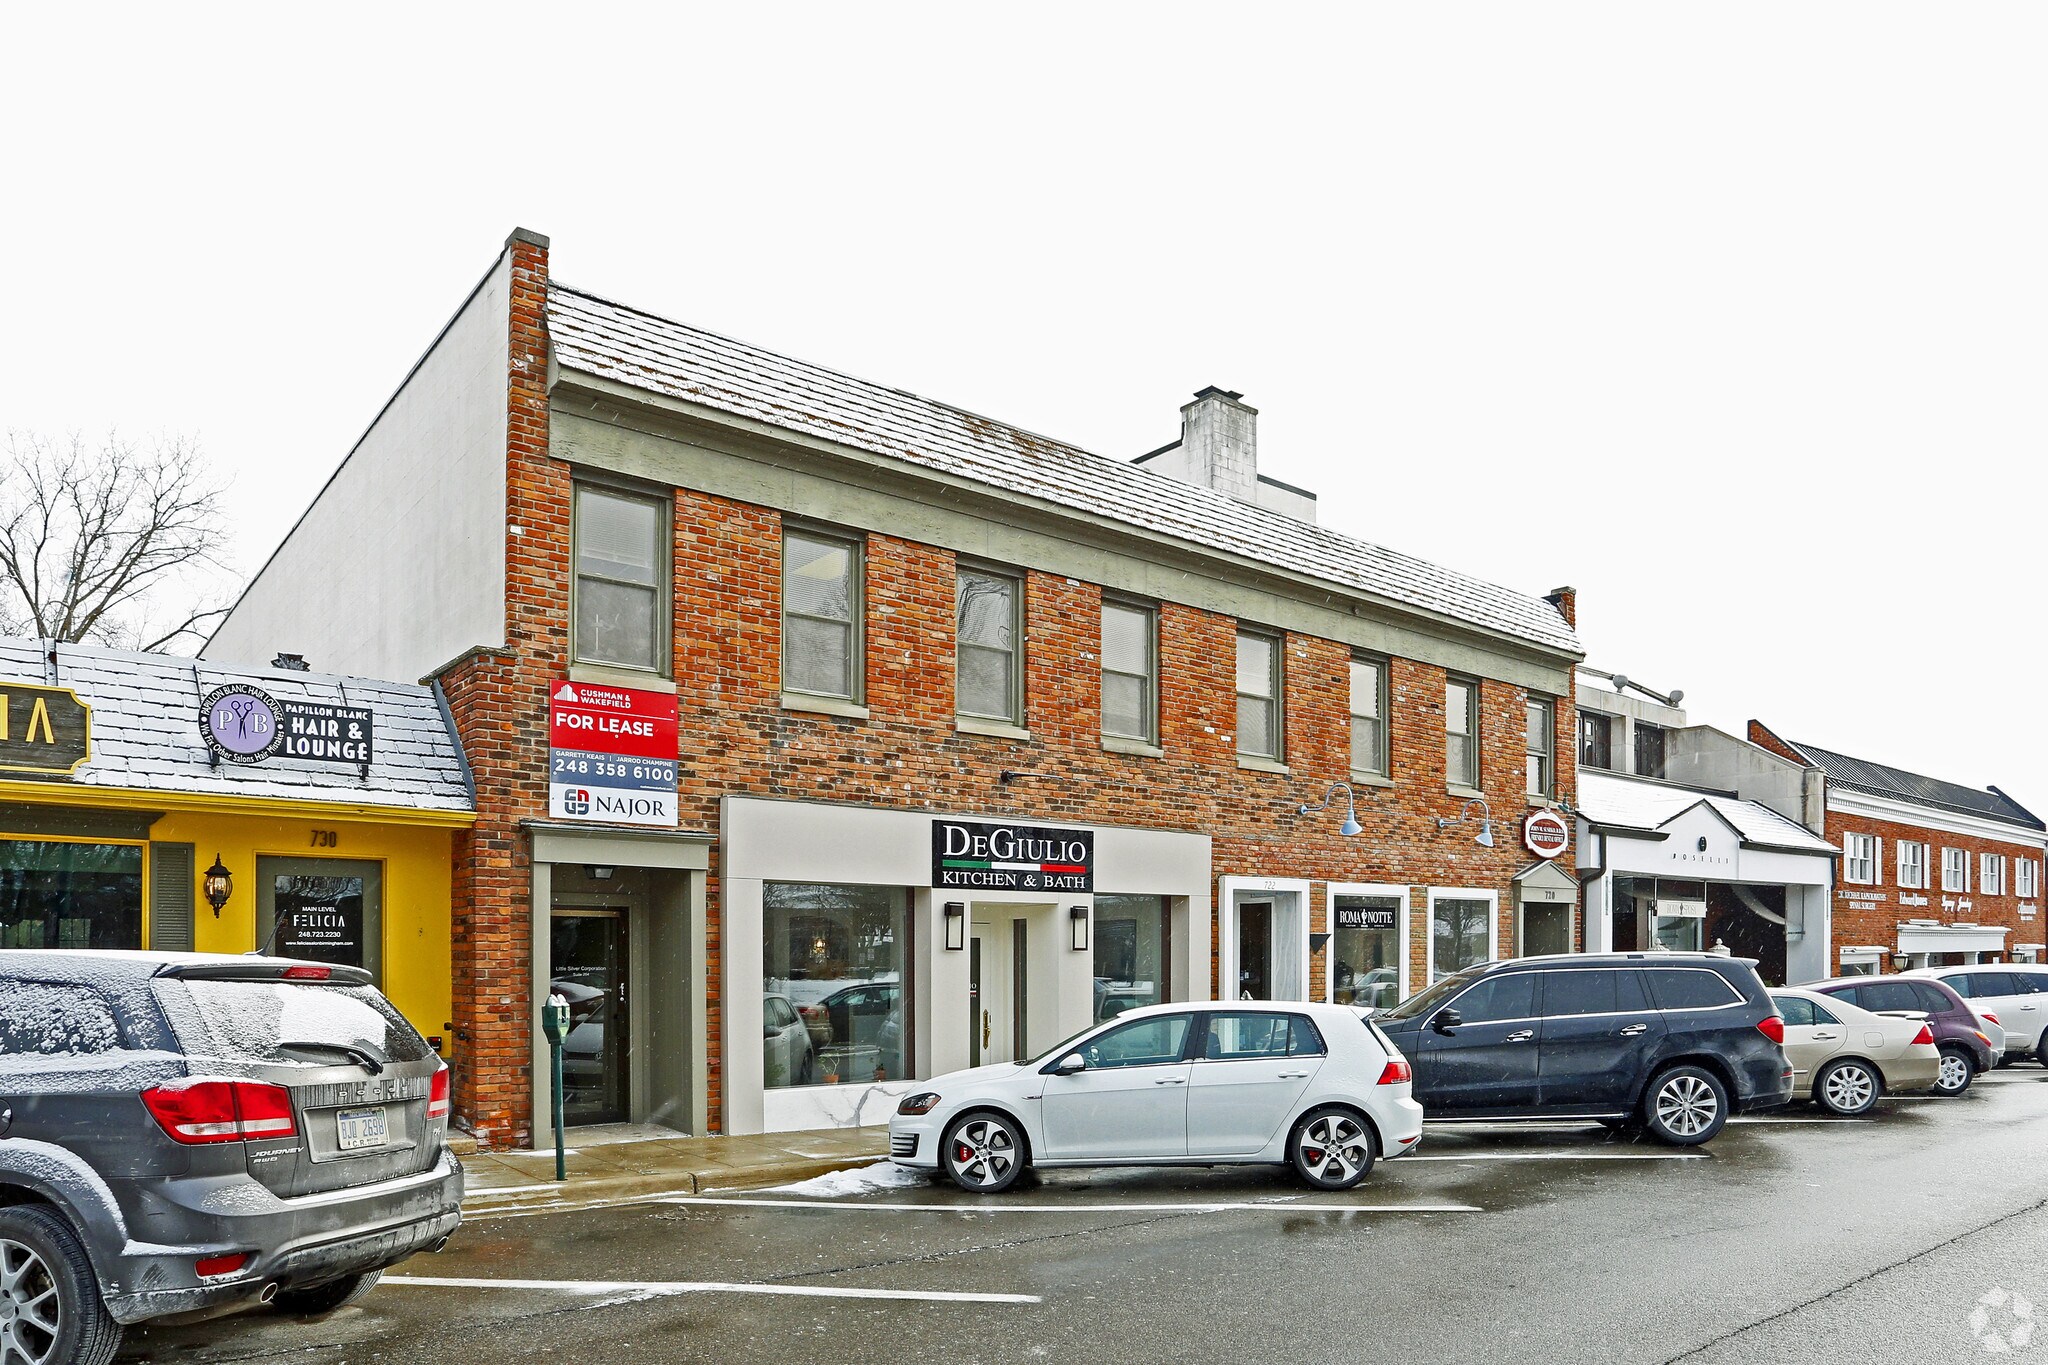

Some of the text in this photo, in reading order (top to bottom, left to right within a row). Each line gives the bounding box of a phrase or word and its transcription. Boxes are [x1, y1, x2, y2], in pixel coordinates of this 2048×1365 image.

[201, 685, 284, 722] PAPILLON BLANC HAIR LOUNGE
[580, 689, 631, 702] CUSHMAN &
[580, 696, 631, 709] WAKEFIELD
[285, 703, 368, 720] PAPILLON BLANC
[291, 717, 363, 740] HAIR &
[556, 712, 654, 737] FOR LEASE
[200, 724, 285, 763] We Fix Other Salons Hair Mistakes
[286, 736, 368, 760] LOUNGE
[555, 750, 673, 768] GARRETT KEAIS JARROD CHAMPINE
[555, 759, 674, 781] 248 358 6100
[595, 795, 666, 818] NAJOR
[310, 830, 337, 848] 730
[942, 871, 1086, 889] KITCHEN & BATH
[1264, 881, 1276, 890] 722
[1545, 890, 1556, 900] 720
[293, 914, 346, 928] FELICIA
[1339, 910, 1393, 924] ROMA NOTTE
[250, 1147, 304, 1158] JOURNEY
